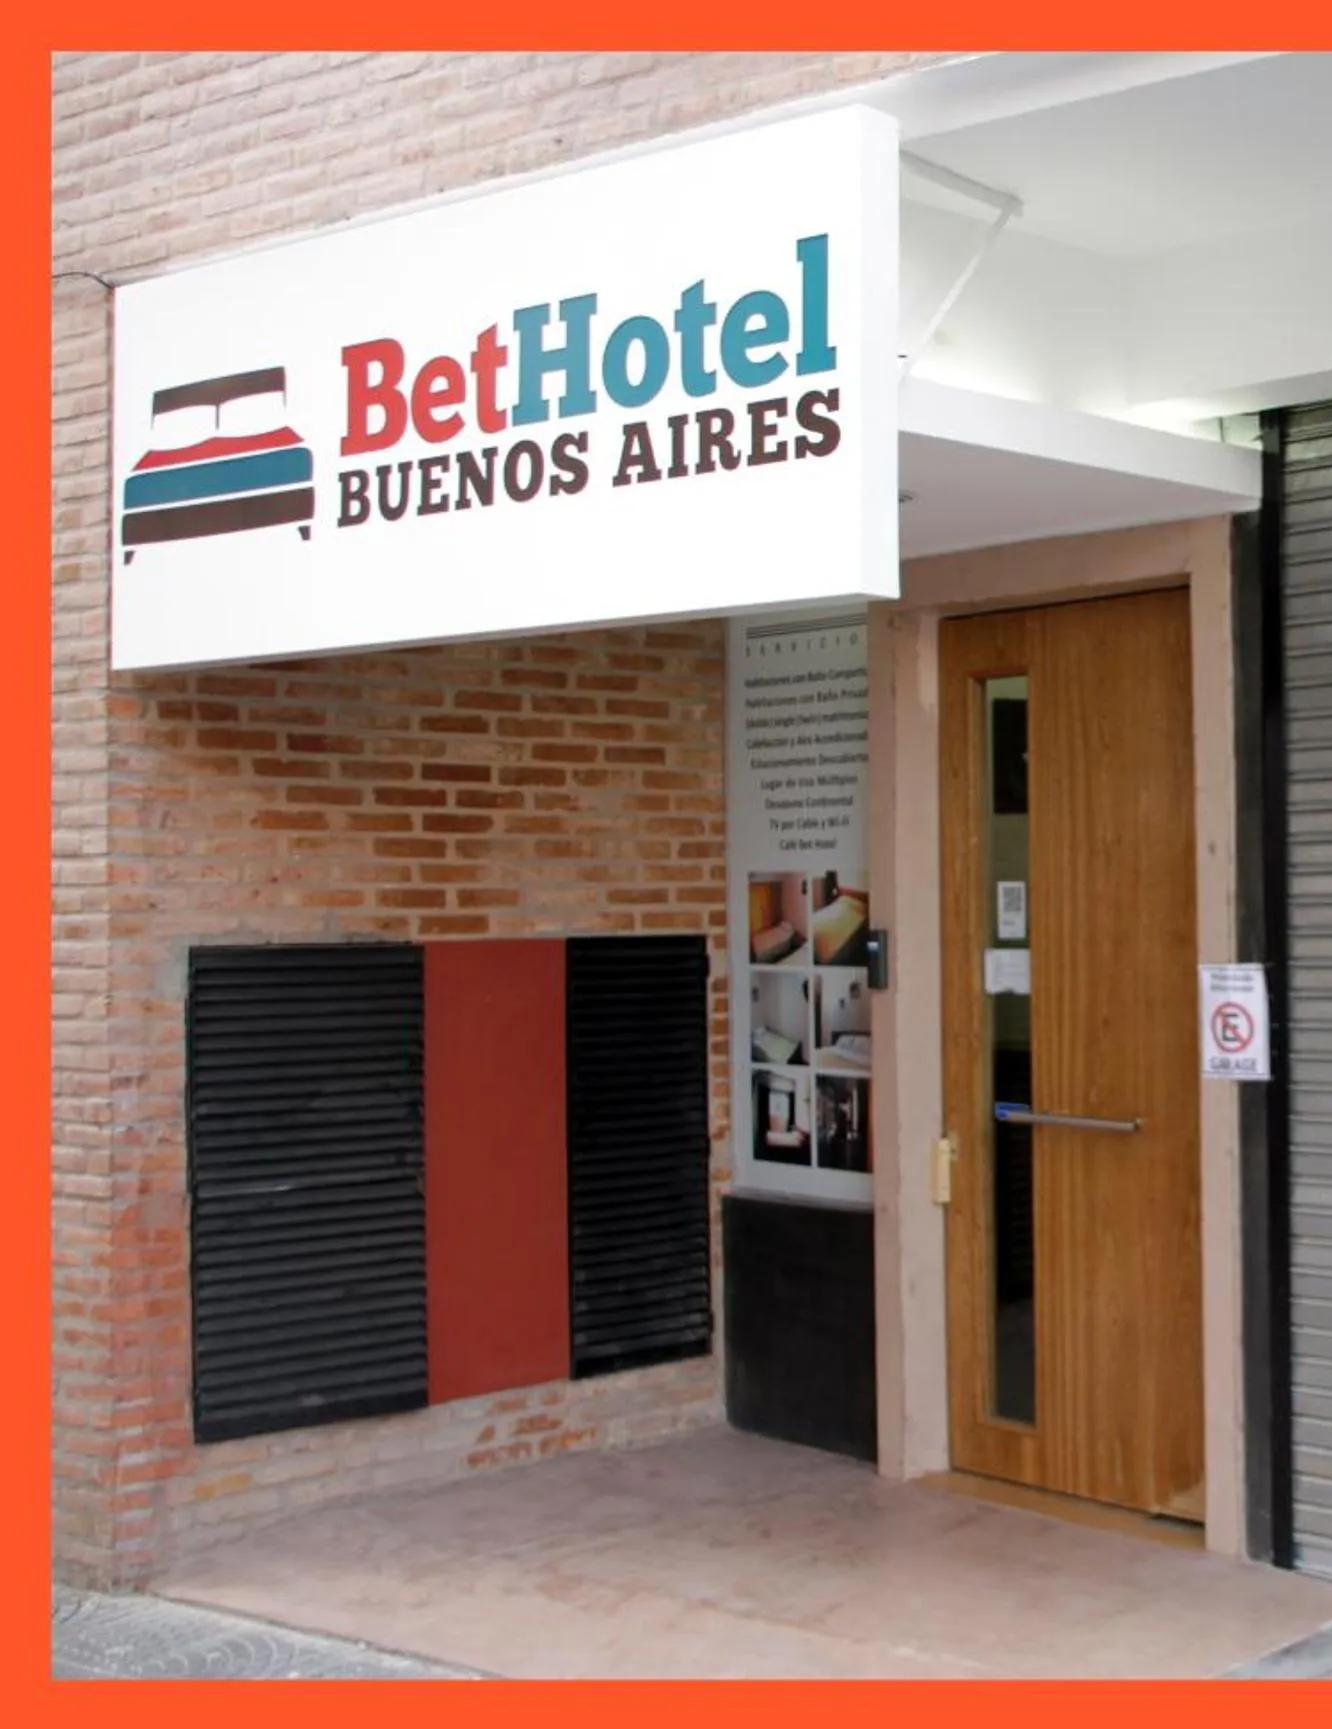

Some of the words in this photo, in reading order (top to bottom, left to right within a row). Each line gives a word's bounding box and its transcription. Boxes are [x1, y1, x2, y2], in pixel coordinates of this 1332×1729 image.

[340, 233, 837, 457] BetHotel
[337, 431, 589, 528] BUENOS
[612, 389, 842, 489] AIRES
